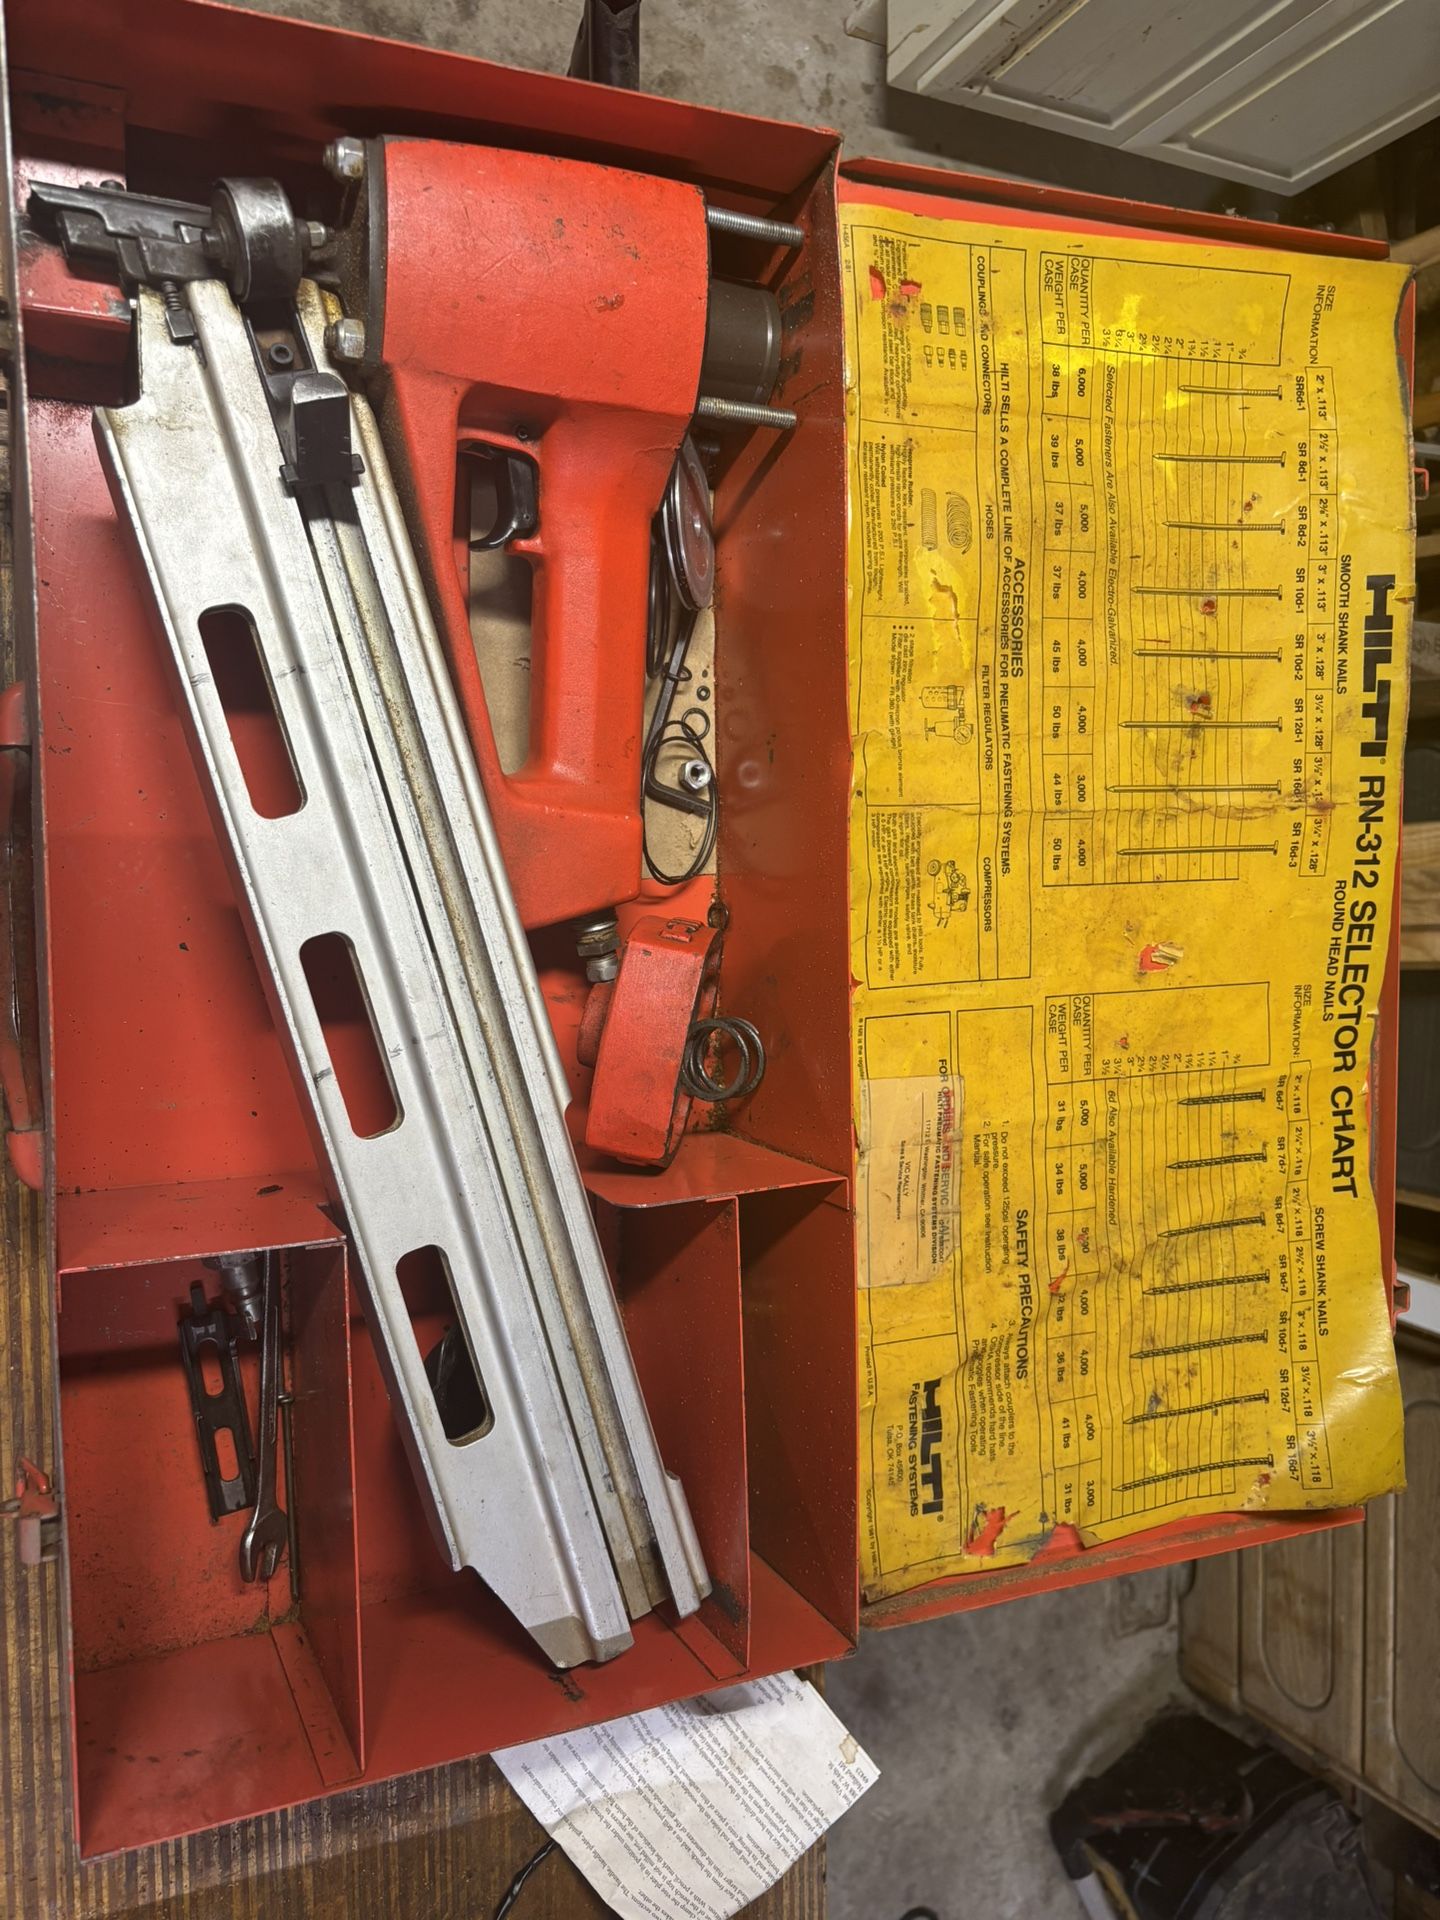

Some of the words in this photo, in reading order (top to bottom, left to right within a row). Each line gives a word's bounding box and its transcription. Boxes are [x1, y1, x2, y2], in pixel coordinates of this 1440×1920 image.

[977, 256, 989, 316] COUPLINGS
[1044, 259, 1053, 291] CASE
[1055, 261, 1064, 308] WEIGHT
[1070, 258, 1080, 290] CASE
[1080, 259, 1090, 318] QUANTITY
[1324, 286, 1335, 311] SIZE
[1056, 312, 1065, 334] PER
[1082, 322, 1090, 344] PER
[1309, 285, 1325, 364] INFORMATION
[981, 345, 991, 415] CONNECTORS
[1001, 363, 1009, 391] HILTI
[1077, 368, 1086, 397] 6,000
[1106, 365, 1117, 412] Selected
[1296, 376, 1305, 410] SR6d-1
[1000, 395, 1010, 432] SELLS
[1000, 437, 1009, 445] A
[1075, 439, 1084, 466] 5,000
[1105, 416, 1115, 467] Fasteners
[1298, 442, 1307, 457] SR
[1000, 449, 1011, 512] COMPLETE
[1106, 471, 1116, 489] Are
[1298, 460, 1307, 481] 8d-1
[1055, 502, 1063, 515] 37
[1106, 492, 1116, 515] Also
[1298, 506, 1307, 520] SR
[1003, 517, 1012, 542] LINE
[1055, 519, 1063, 536] lbs
[1080, 504, 1089, 532] 5,000
[1107, 517, 1120, 564] Available
[1297, 524, 1307, 546] 8d-2
[1004, 546, 1012, 562] OF
[1078, 571, 1086, 599] 4,000
[1296, 568, 1305, 583] SR
[1339, 555, 1351, 608] SMOOTH
[1001, 566, 1011, 649] ACCESSORIES
[1296, 588, 1304, 613] 10d-1
[1011, 558, 1025, 677] ACCESSORIES
[1106, 567, 1120, 666] Electro-Galvanized.
[1338, 612, 1349, 655] SHANK
[1000, 654, 1009, 677] FOR
[1337, 659, 1347, 694] NAILS
[1360, 574, 1395, 757] HILTI
[982, 665, 990, 698] FILTER
[1000, 683, 1010, 749] PNEUMATIC
[1295, 698, 1303, 712] SR
[984, 703, 993, 770] REGULATORS
[1295, 718, 1303, 742] 12d-1
[1003, 754, 1013, 817] FASTENING
[1054, 773, 1062, 785] 44
[1076, 775, 1086, 802] 3,000
[1054, 790, 1062, 805] lbs
[1292, 822, 1302, 836] SR
[1352, 776, 1385, 888] RN-312
[1001, 822, 1012, 877] SYSTEMS.
[1289, 841, 1299, 867] 16d-3
[983, 857, 992, 932] COMPRESSORS
[1332, 880, 1347, 932] ROUND
[1327, 937, 1342, 976] HEAD
[1303, 985, 1311, 1005] SIZE
[1333, 901, 1377, 1072] SELECTOR
[1073, 997, 1081, 1025] CASE
[1323, 981, 1336, 1021] NAILS
[1058, 1003, 1067, 1046] WEIGHT
[1083, 996, 1091, 1049] QUANTITY
[1293, 985, 1302, 1056] INFORMATION:
[1060, 1050, 1068, 1072] PER
[1083, 1054, 1091, 1075] PER
[1277, 1075, 1287, 1087] SR
[1058, 1101, 1065, 1111] 31
[1108, 1090, 1116, 1102] 6d
[1276, 1091, 1284, 1111] 6d-7
[1056, 1117, 1065, 1131] lbs
[1080, 1100, 1089, 1126] 5,000
[1109, 1107, 1117, 1126] Also
[1001, 1132, 1008, 1143] Do
[1278, 1137, 1285, 1150] SR
[1331, 1086, 1358, 1198] CHART
[1106, 1129, 1119, 1175] Available
[1278, 1154, 1286, 1174] 7d-7
[982, 1171, 991, 1210] operation
[1109, 1178, 1119, 1225] Hardened
[1275, 1196, 1282, 1209] SR
[1001, 1197, 1010, 1222] 125psi
[1276, 1213, 1284, 1233] 8d-7
[1016, 1210, 1028, 1267] SAFETY
[1315, 1207, 1324, 1250] SCREW
[1279, 1255, 1287, 1268] SR
[1280, 1272, 1288, 1292] 9d-7
[1316, 1255, 1326, 1296] SHANK
[1016, 1274, 1032, 1379] PRECAUTIONS
[1280, 1311, 1287, 1324] SR
[1318, 1301, 1328, 1336] NAILS
[1279, 1328, 1287, 1353] 10d-7
[1057, 1352, 1065, 1364] 36
[1080, 1350, 1088, 1375] 4,000
[1057, 1367, 1065, 1382] lbs
[1280, 1369, 1289, 1383] SR
[1281, 1386, 1290, 1412] 12d-7
[908, 1383, 920, 1450] FASTENING
[887, 1449, 894, 1460] OK
[921, 1377, 943, 1515] HILTI
[1286, 1435, 1295, 1449] SR
[1289, 1454, 1299, 1481] 16d-7
[909, 1455, 918, 1517] SYSTEMS
[1086, 1480, 1094, 1507] 3,000
[603, 1819, 612, 1830] the
[650, 1875, 663, 1889] plate
[671, 1897, 680, 1906] the
